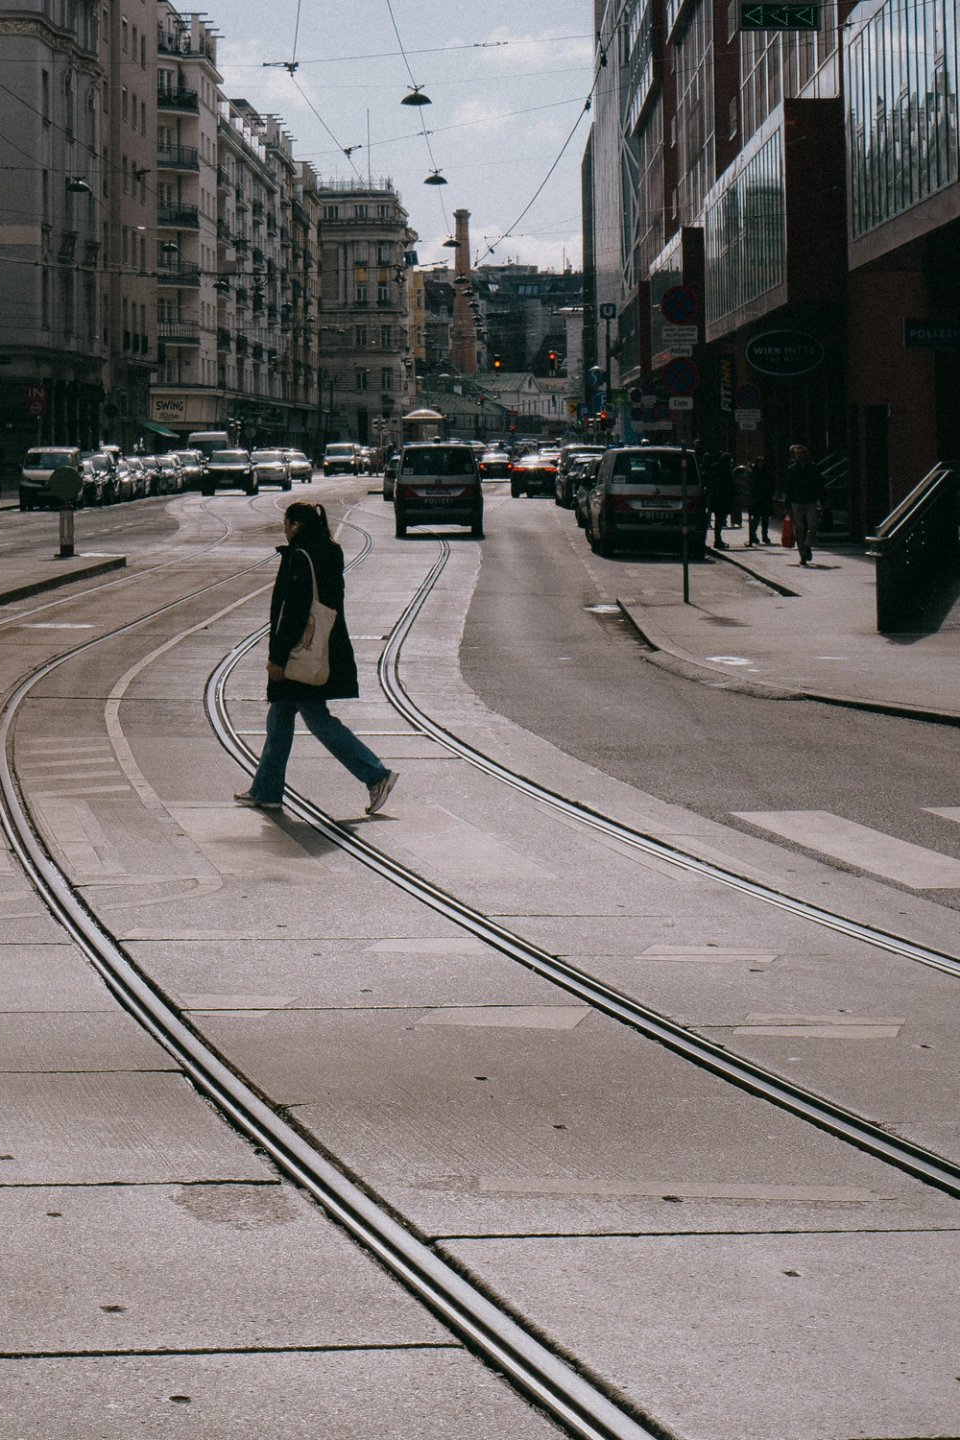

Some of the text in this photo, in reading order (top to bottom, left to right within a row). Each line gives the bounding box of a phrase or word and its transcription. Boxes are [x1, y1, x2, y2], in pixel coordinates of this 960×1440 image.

[910, 329, 958, 338] POLIZEI
[753, 346, 781, 355] WIEN
[156, 400, 184, 411] SWING
